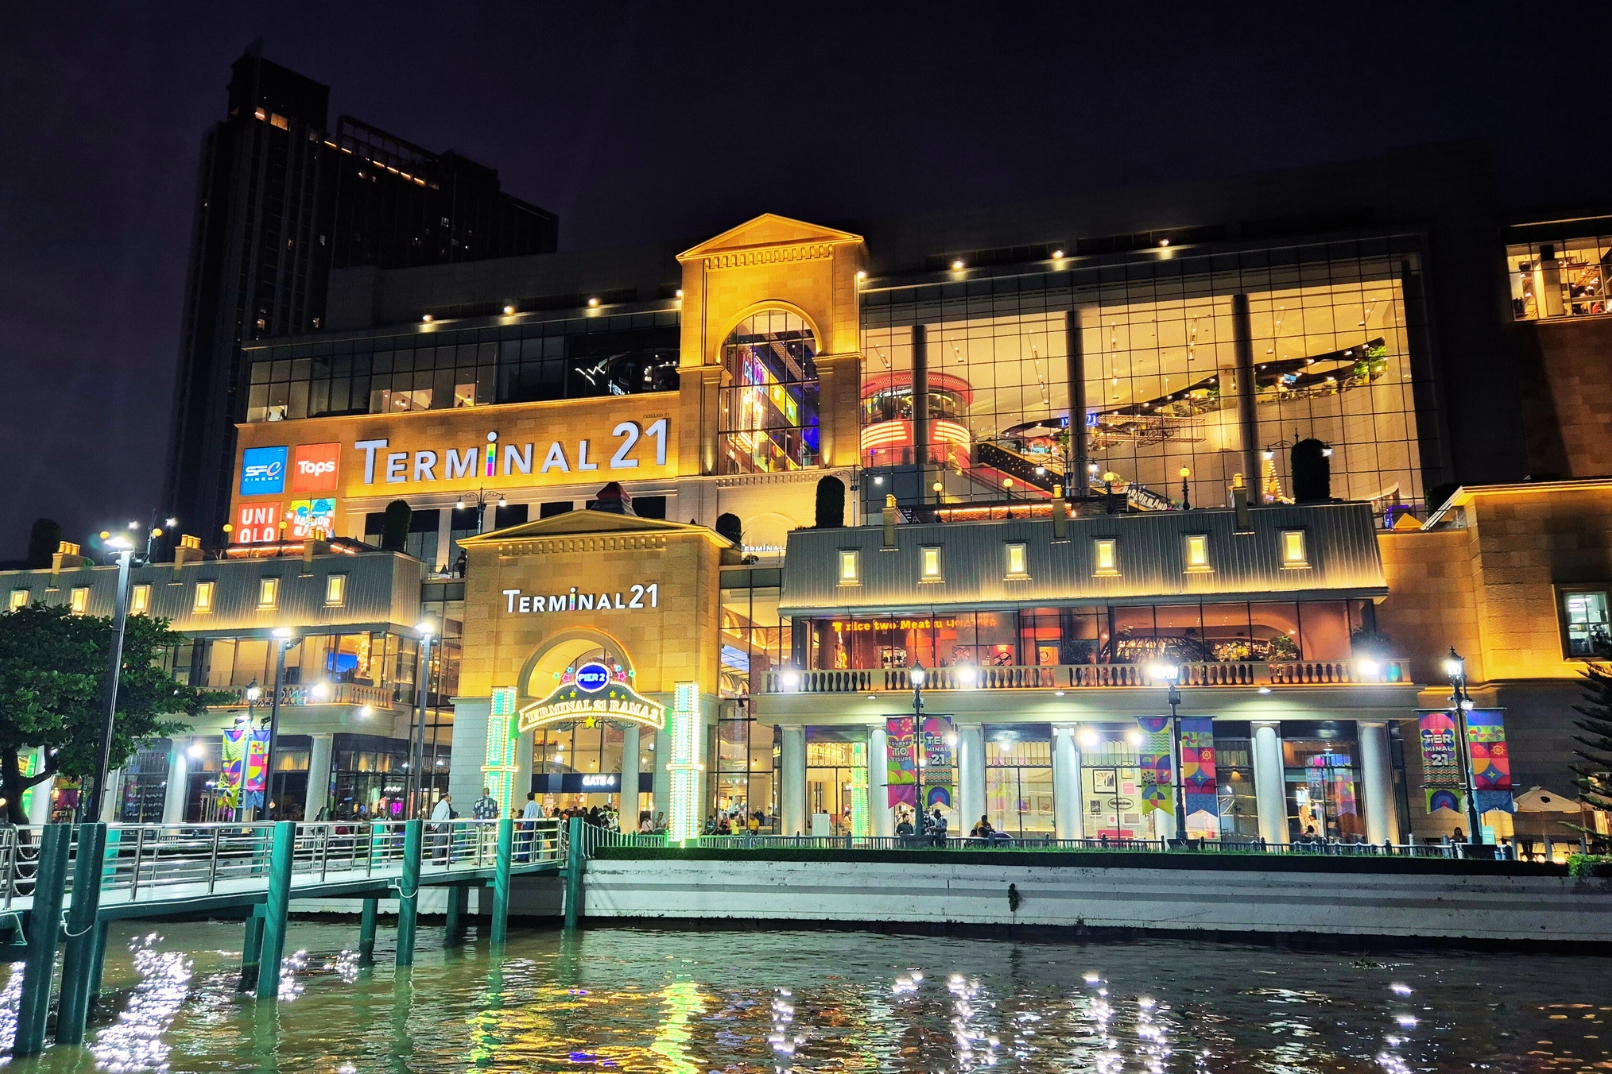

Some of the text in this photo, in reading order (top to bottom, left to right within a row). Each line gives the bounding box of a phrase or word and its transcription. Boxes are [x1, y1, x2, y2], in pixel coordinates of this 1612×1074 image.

[610, 417, 669, 468] 21
[297, 460, 336, 477] Tops
[241, 507, 274, 525] UNI
[629, 583, 659, 609] 21
[873, 620, 896, 631] two
[900, 619, 931, 630] Meat
[578, 673, 606, 682] PIER 2
[525, 699, 593, 723] TERMINAL
[593, 701, 607, 711] 21
[609, 701, 649, 718] RAMA
[1423, 734, 1452, 744] TER
[892, 747, 908, 756] TO
[931, 754, 945, 765] 21
[1430, 754, 1449, 767] 21
[582, 774, 607, 786] GATE
